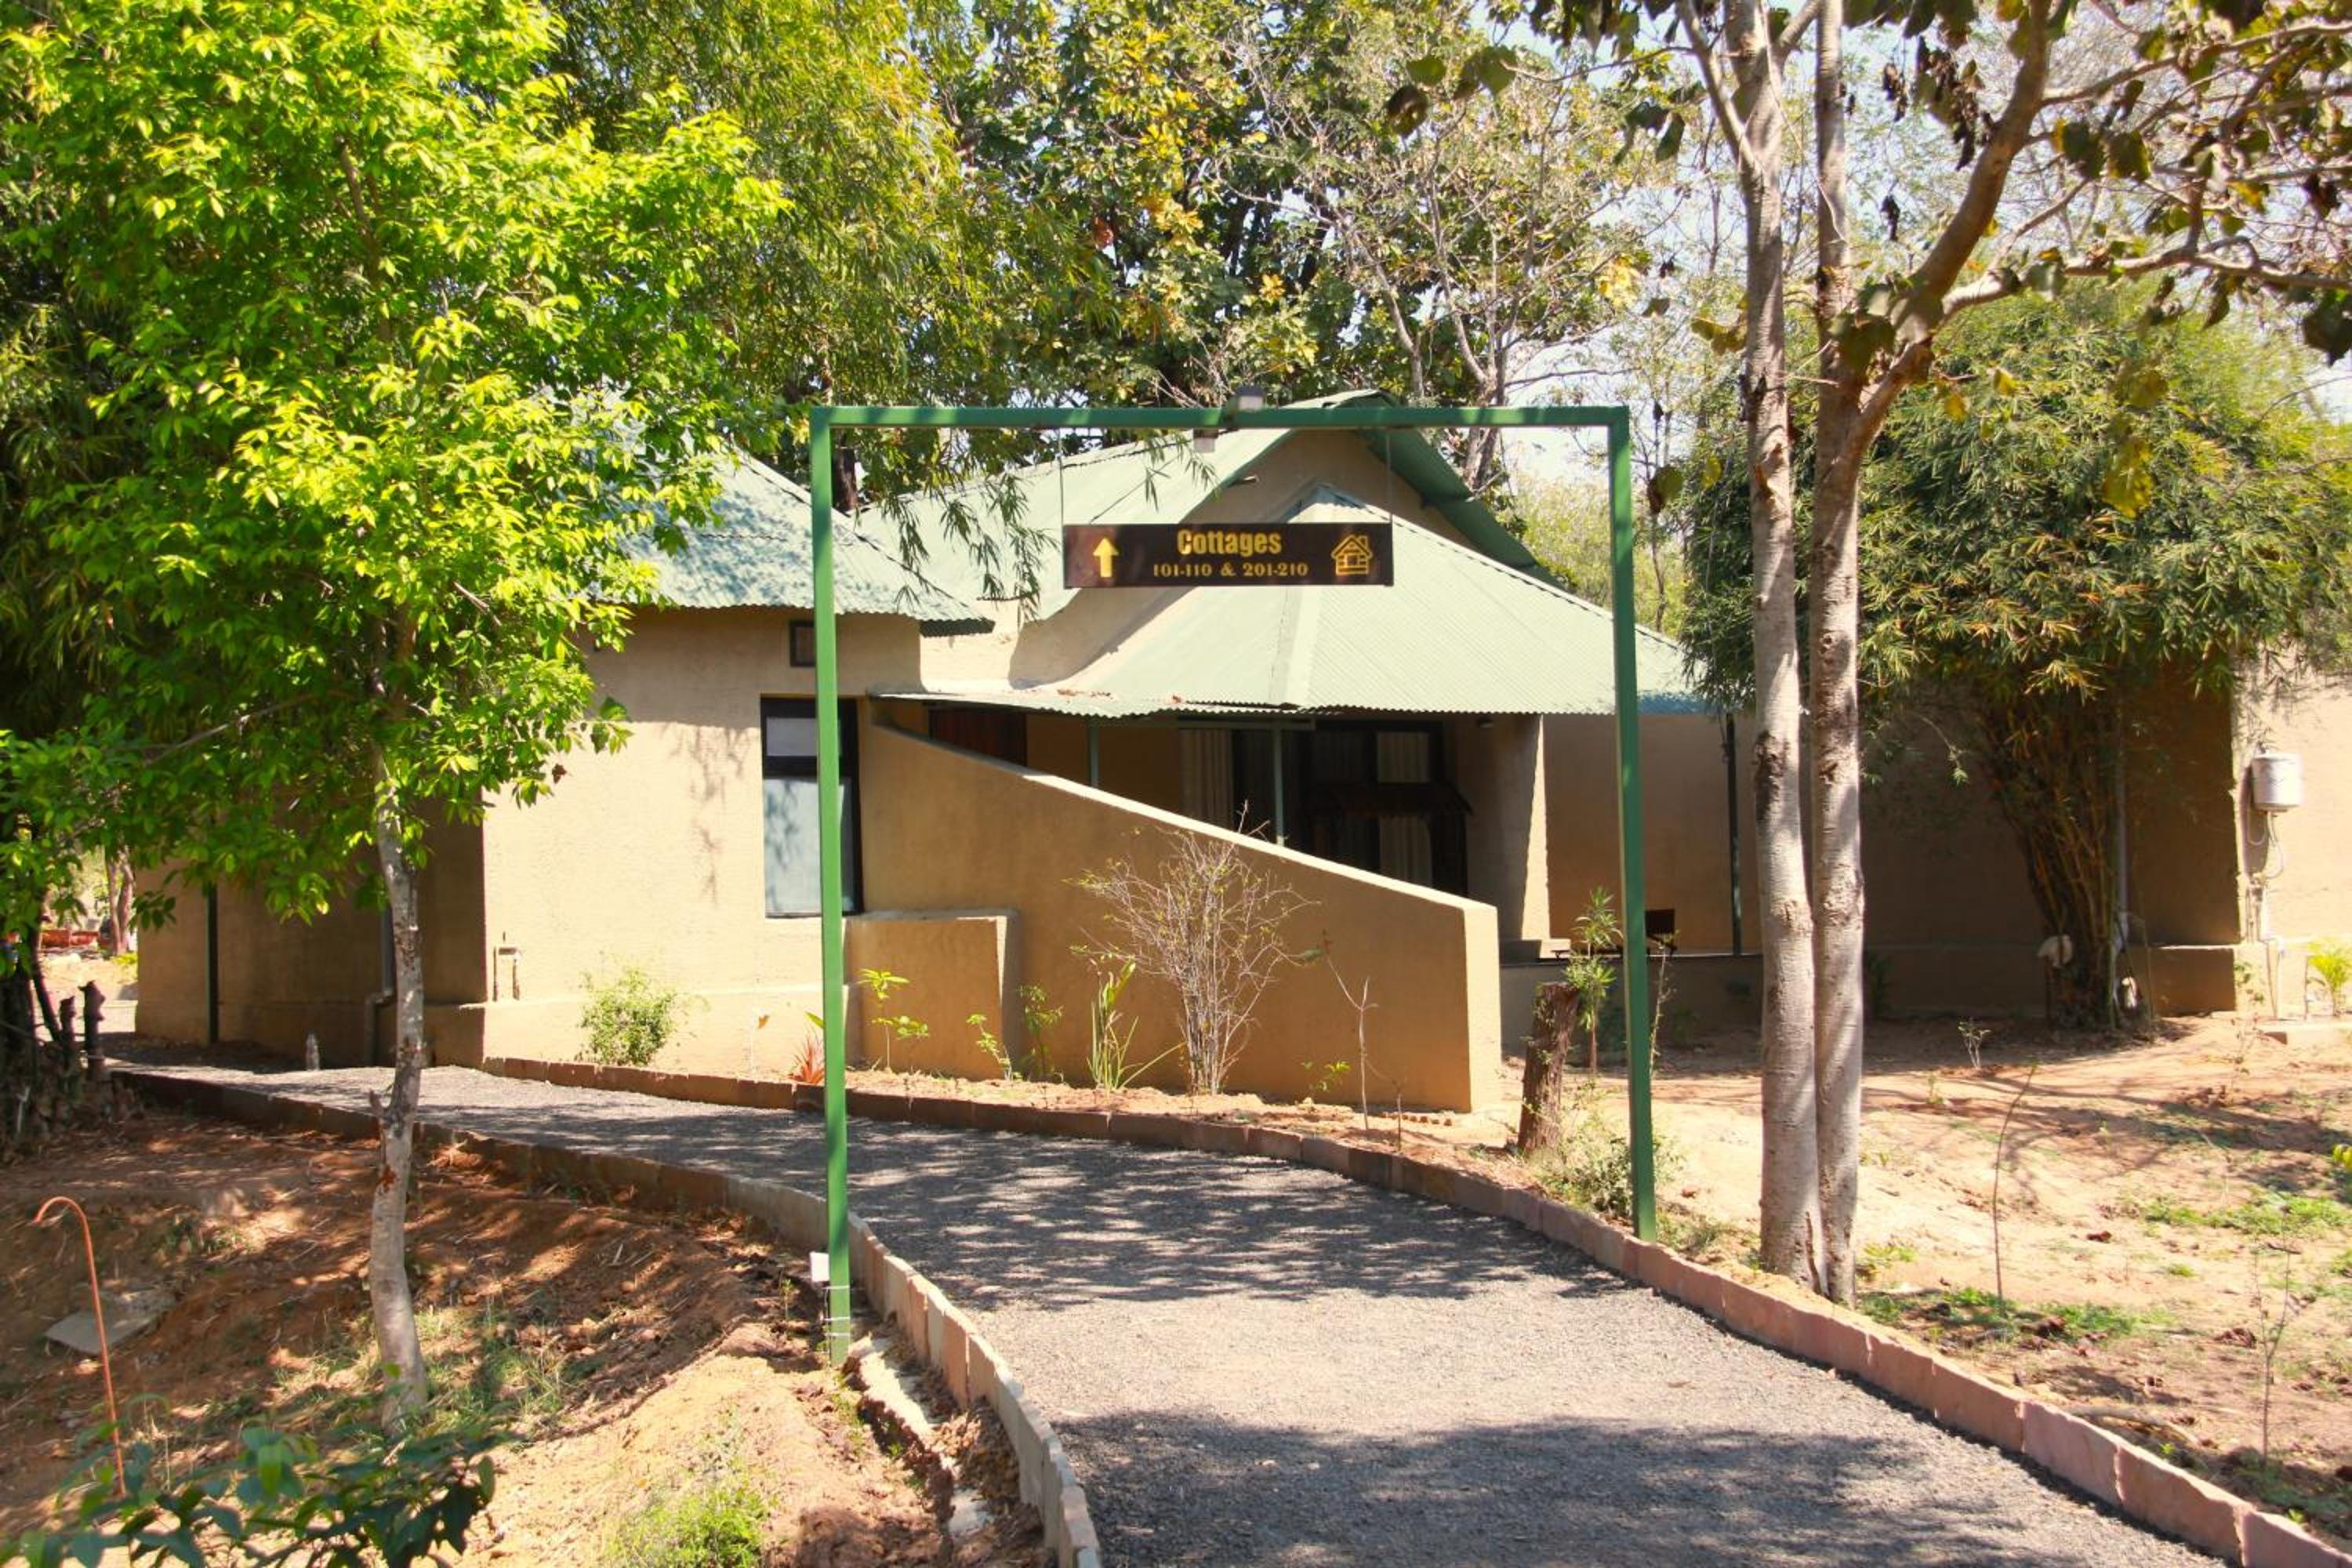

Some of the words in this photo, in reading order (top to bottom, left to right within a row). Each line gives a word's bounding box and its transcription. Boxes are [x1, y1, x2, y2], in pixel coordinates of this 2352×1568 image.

[1177, 528, 1282, 557] Cottages
[1153, 563, 1212, 576] 101-110
[1220, 562, 1236, 576] &
[1243, 563, 1308, 576] 201-210
